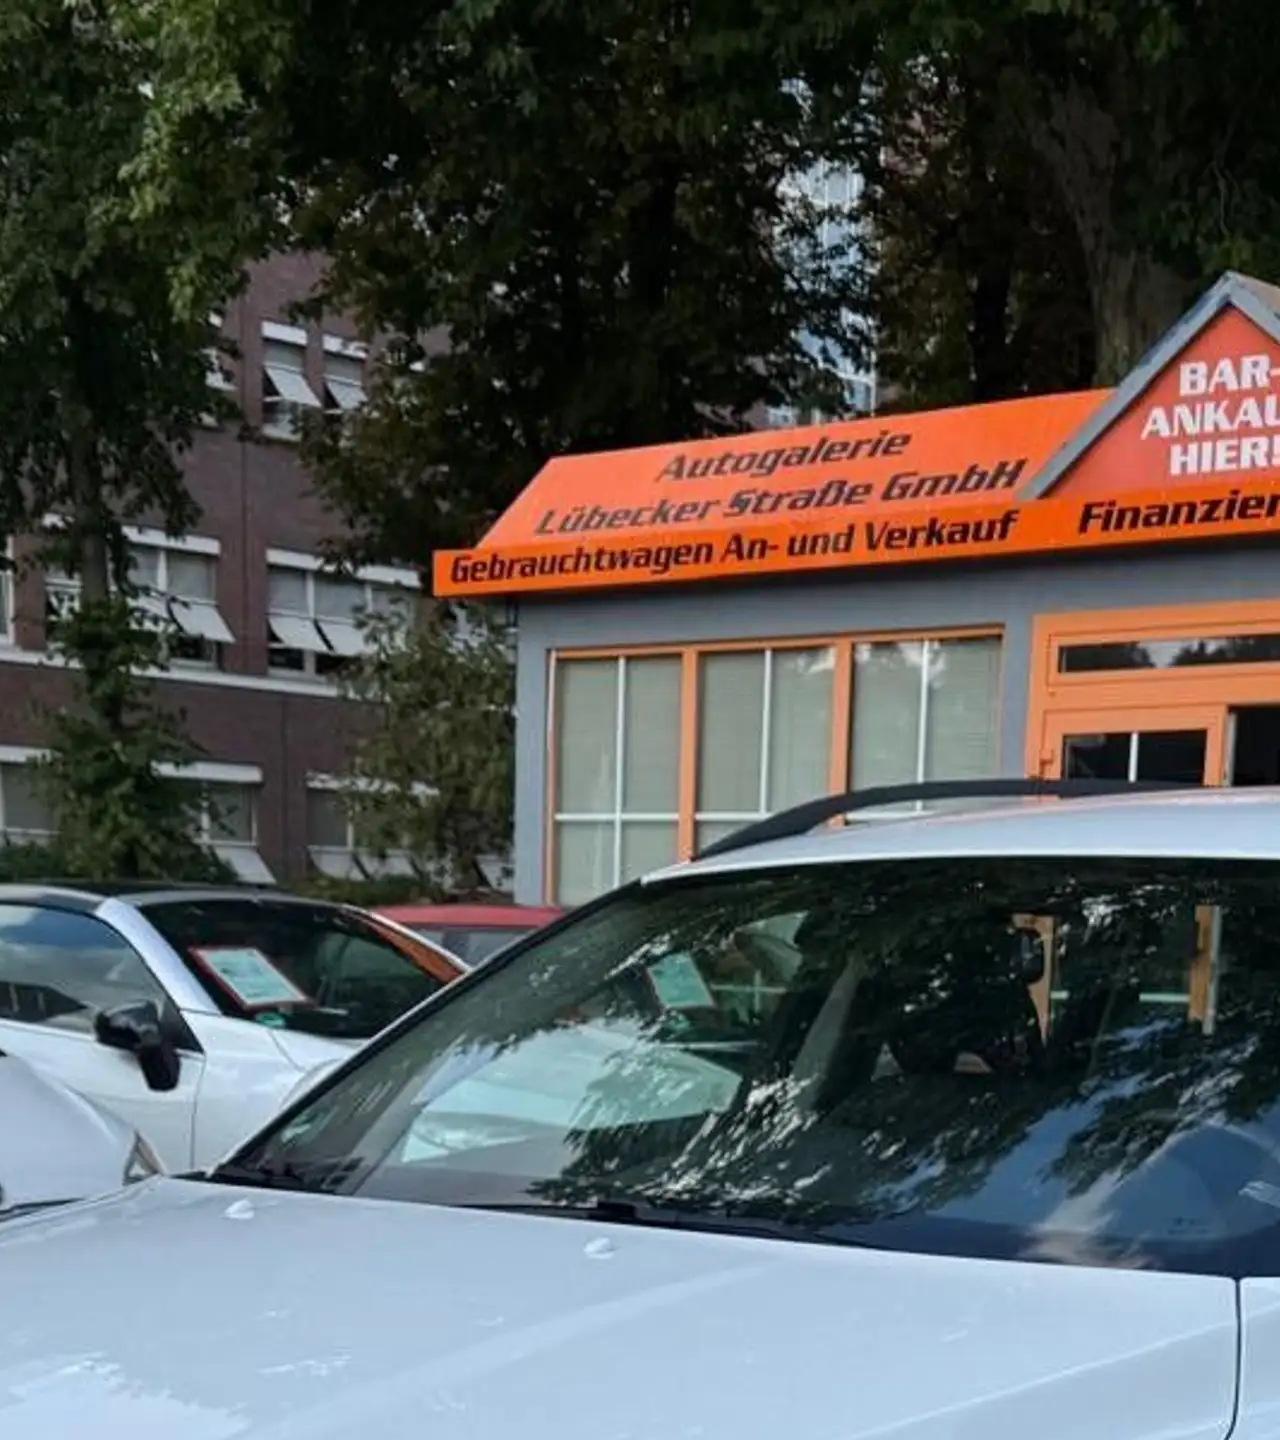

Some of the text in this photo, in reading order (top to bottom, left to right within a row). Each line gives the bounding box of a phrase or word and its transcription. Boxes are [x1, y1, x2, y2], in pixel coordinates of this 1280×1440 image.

[656, 430, 912, 482] Autogalerie
[536, 459, 1027, 536] Lübecker Straße GmbH
[452, 510, 1019, 584] Gebrauchtwagen An- und Verkauf
